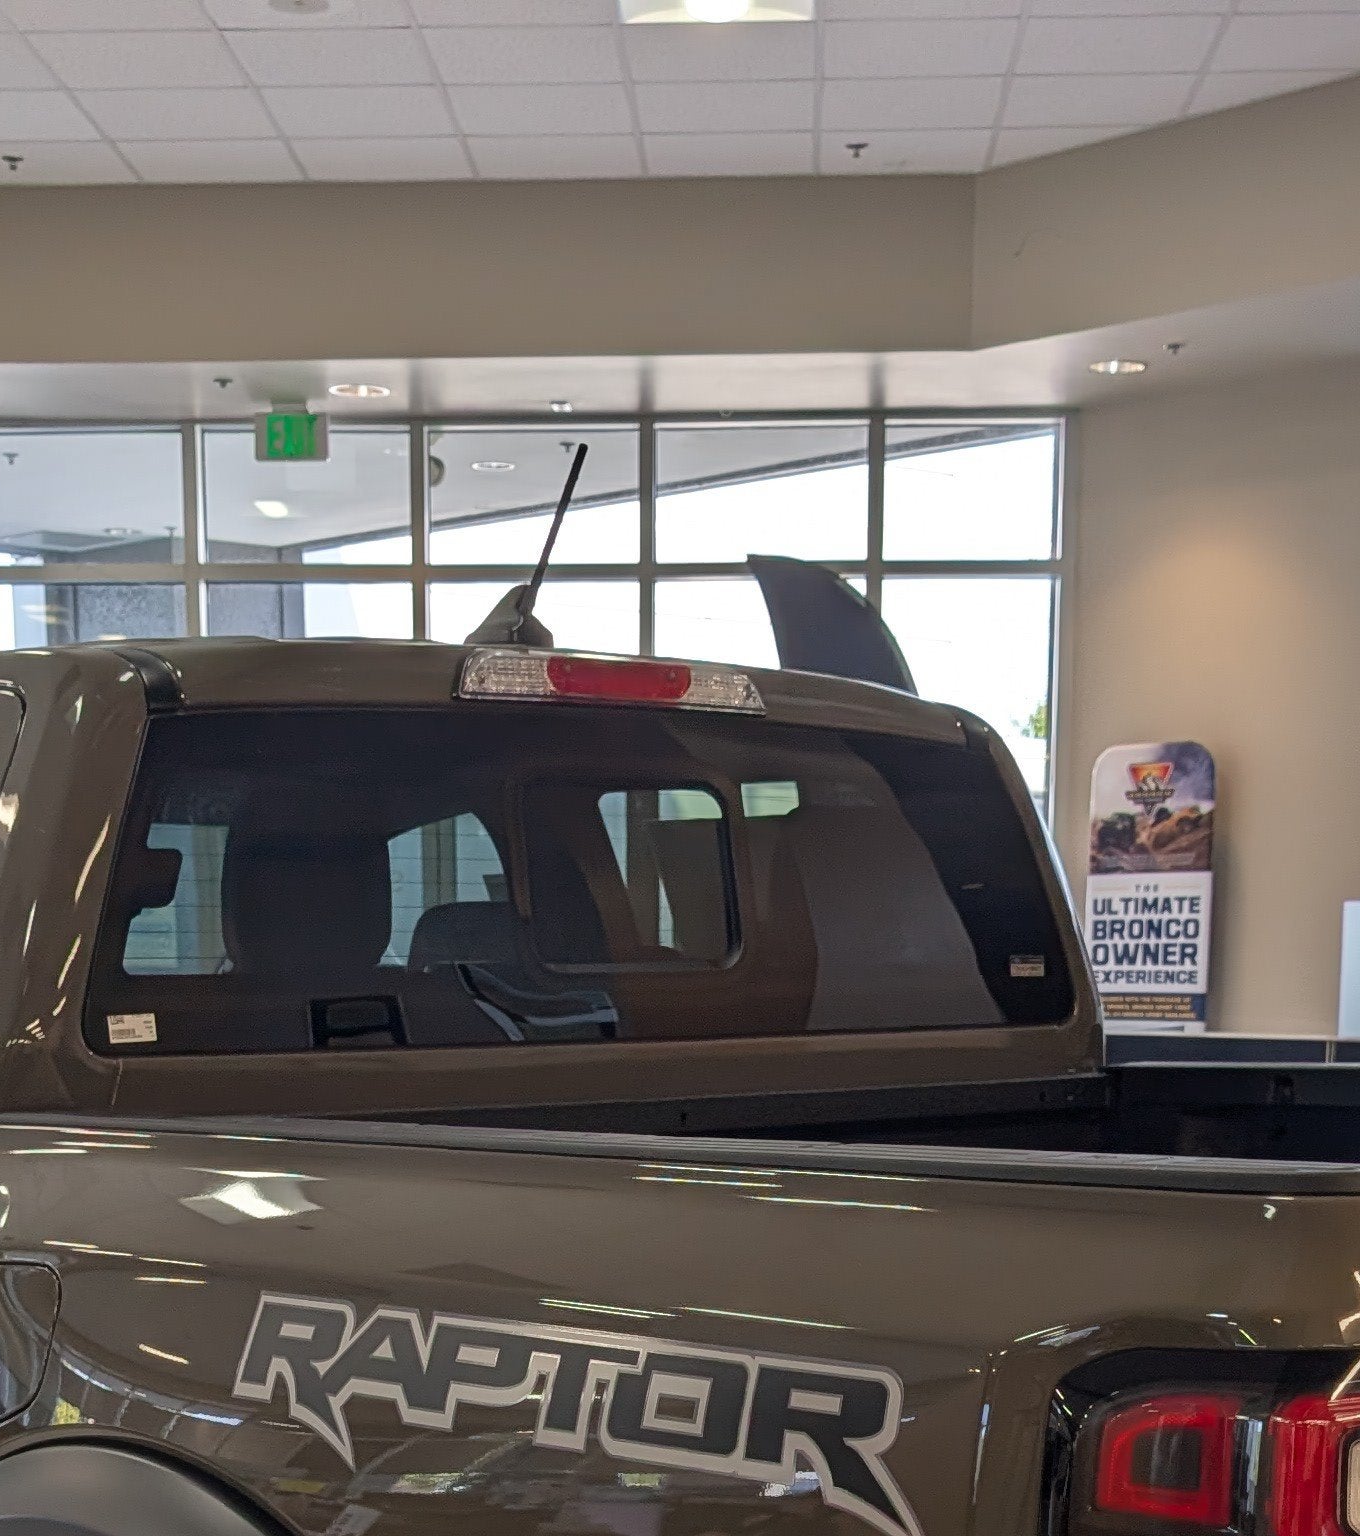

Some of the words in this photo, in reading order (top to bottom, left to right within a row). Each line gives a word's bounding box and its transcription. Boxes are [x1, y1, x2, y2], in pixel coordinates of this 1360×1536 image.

[1134, 883, 1160, 894] THE
[1092, 895, 1201, 916] ULTIMATE
[1091, 918, 1200, 941] BRONCO
[1091, 942, 1198, 966] OWNER
[1093, 969, 1198, 985] EXPERIENCE
